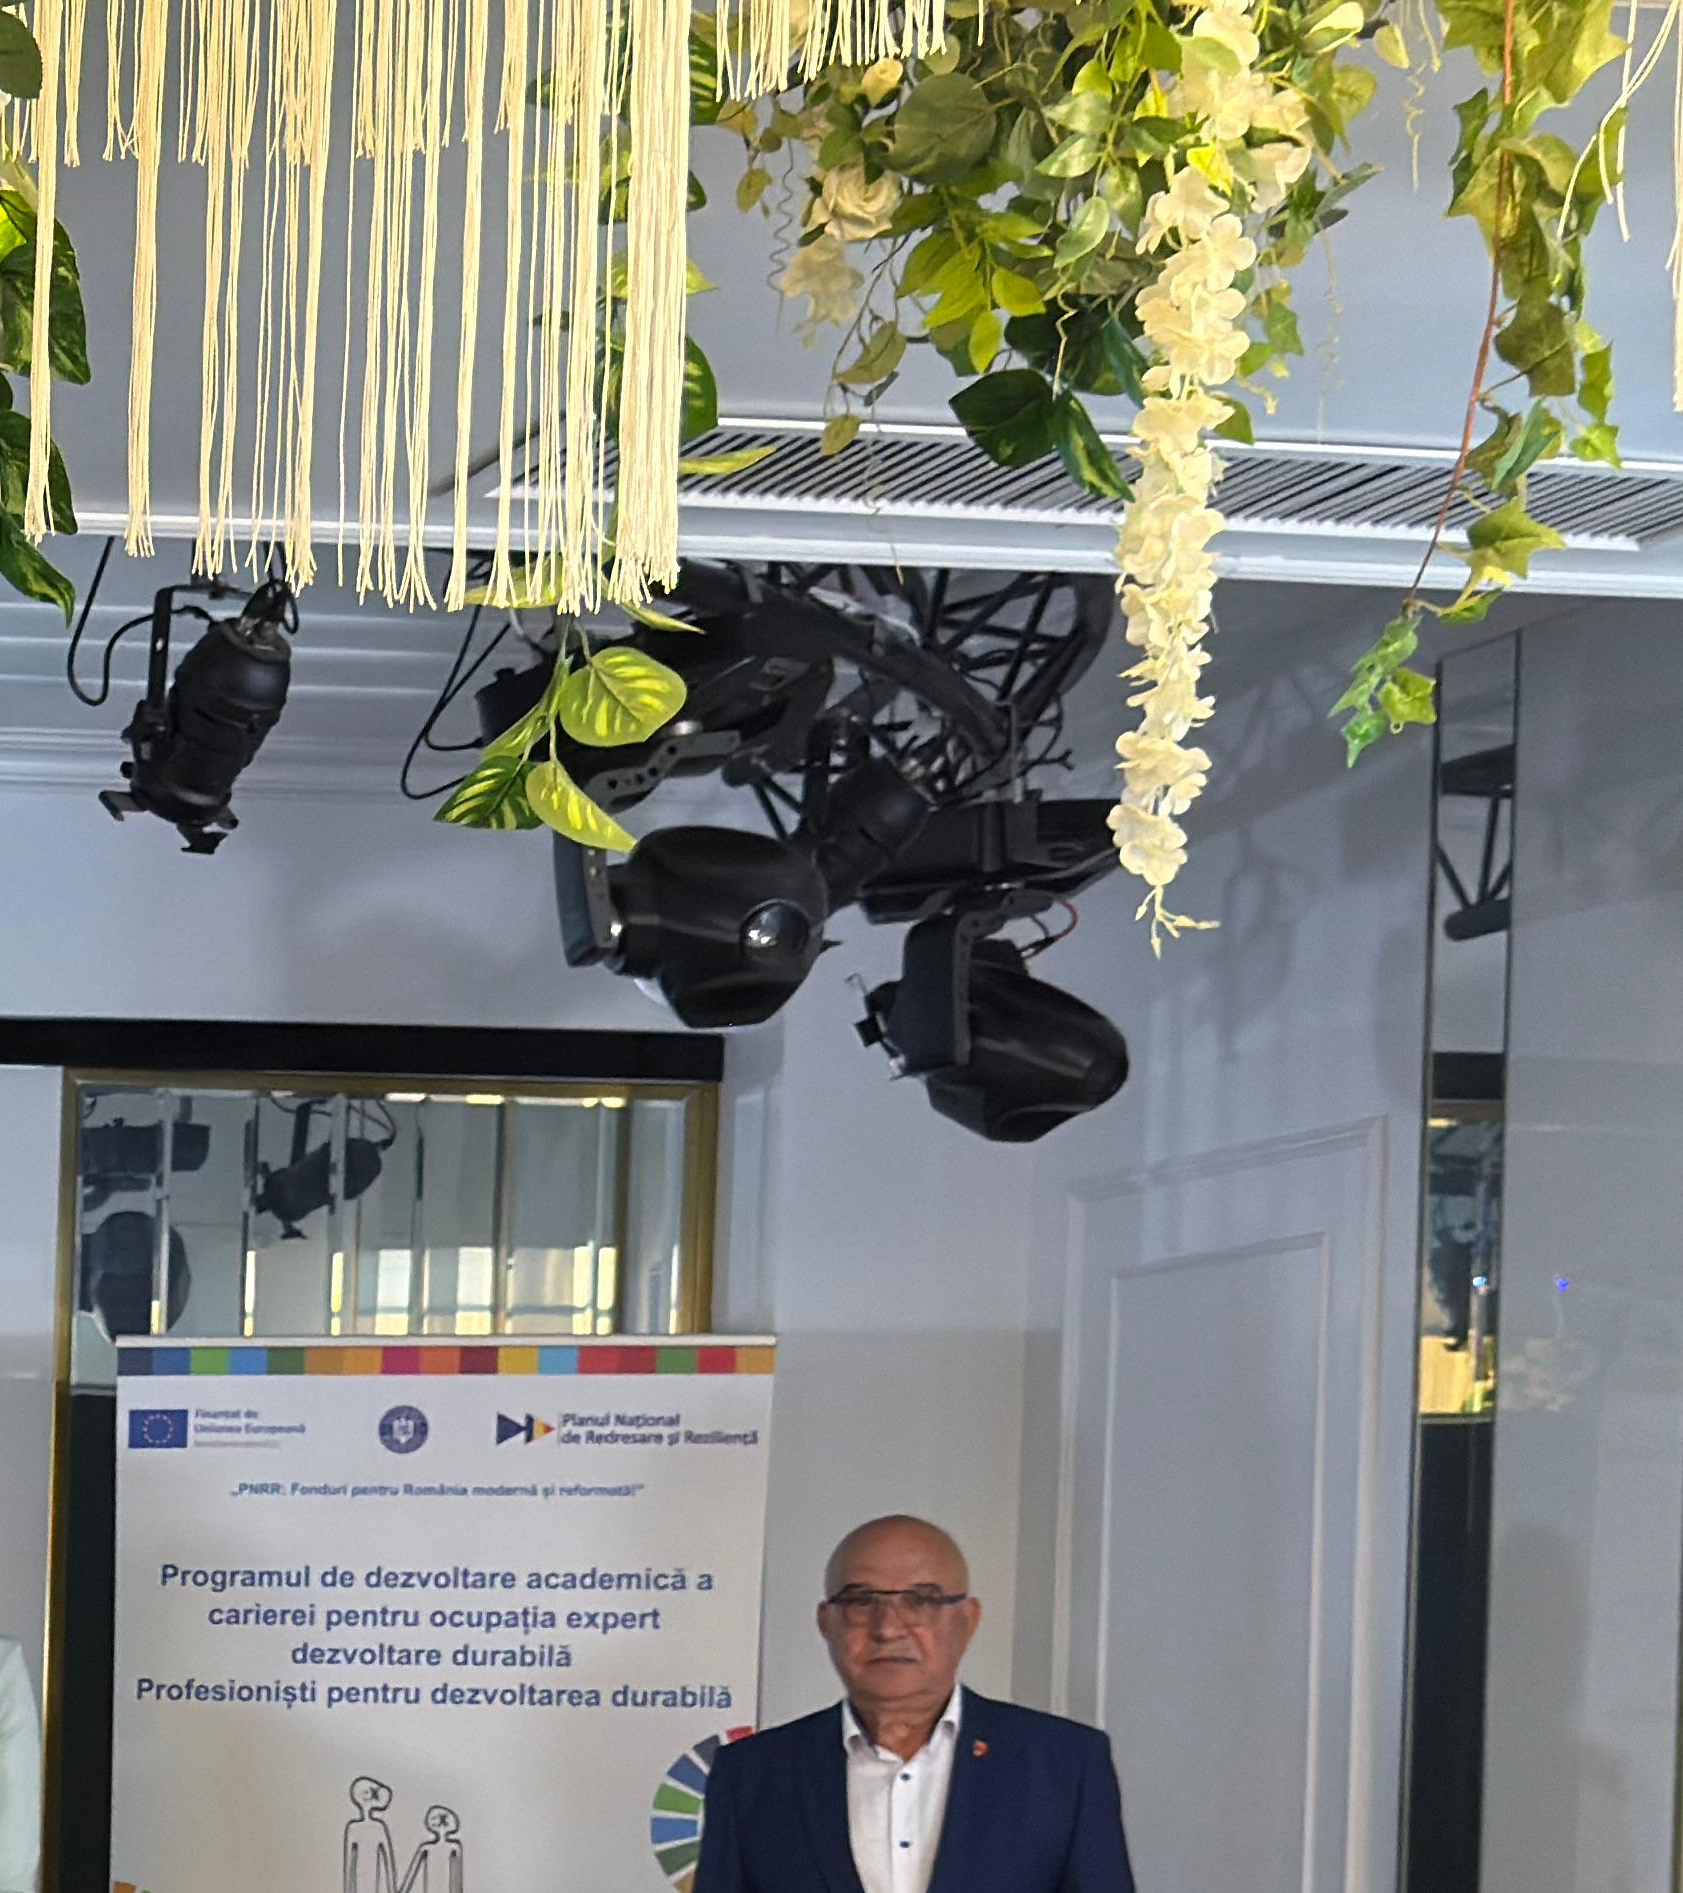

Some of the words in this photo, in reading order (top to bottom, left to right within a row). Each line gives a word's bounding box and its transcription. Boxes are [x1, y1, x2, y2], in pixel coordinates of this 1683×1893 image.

[562, 1413, 611, 1427] Planul
[560, 1431, 581, 1444] de
[585, 1431, 663, 1445] Redresare
[160, 1564, 310, 1593] Programul
[321, 1566, 355, 1588] de
[365, 1566, 516, 1590] dezvoltare
[526, 1567, 687, 1591] academică
[696, 1573, 714, 1591] a
[208, 1603, 315, 1627] carierei
[325, 1606, 419, 1631] pentru
[430, 1606, 556, 1635] ocupația
[566, 1608, 660, 1635] expert
[291, 1642, 441, 1666] dezvoltare
[452, 1644, 572, 1667] durabilă
[136, 1678, 316, 1710] Profesioniști
[327, 1681, 420, 1708] pentru
[431, 1682, 601, 1707] dezvoltarea
[611, 1684, 732, 1709] durabilă
